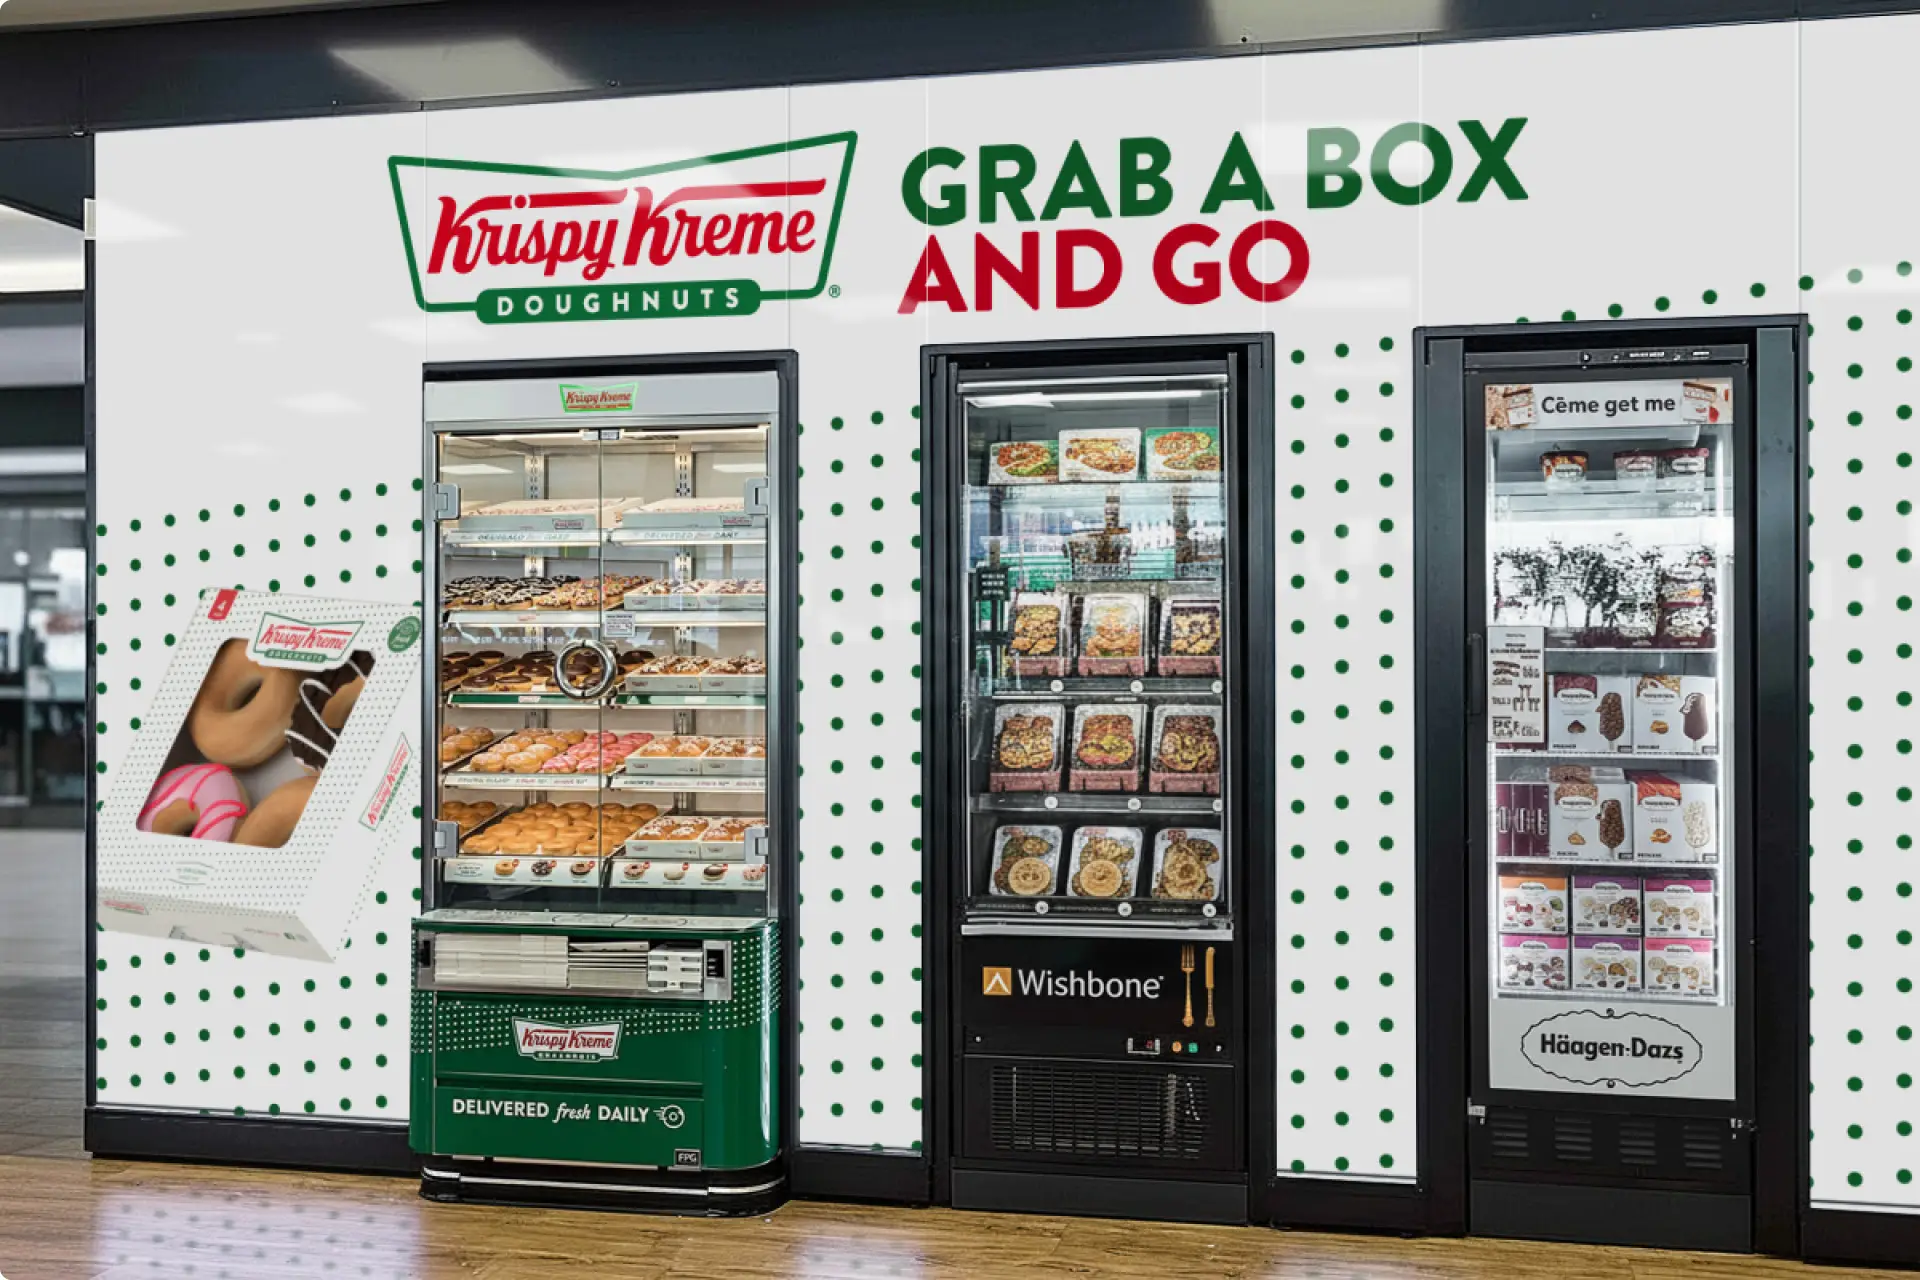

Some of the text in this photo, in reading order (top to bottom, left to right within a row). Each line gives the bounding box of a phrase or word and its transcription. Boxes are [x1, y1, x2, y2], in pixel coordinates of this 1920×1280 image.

[901, 117, 1529, 226] GRAB A BOX
[426, 178, 827, 281] Krispy Kreme
[897, 219, 1311, 316] AND GO
[496, 287, 739, 316] DOUGHNUTS
[1604, 398, 1640, 418] get
[1644, 398, 1676, 413] me
[1017, 968, 1162, 999] Wishbone
[522, 1027, 615, 1051] Krispy Kreme
[452, 1098, 649, 1124] DELIVERED fresh DAILY
[678, 1153, 697, 1163] FPG
